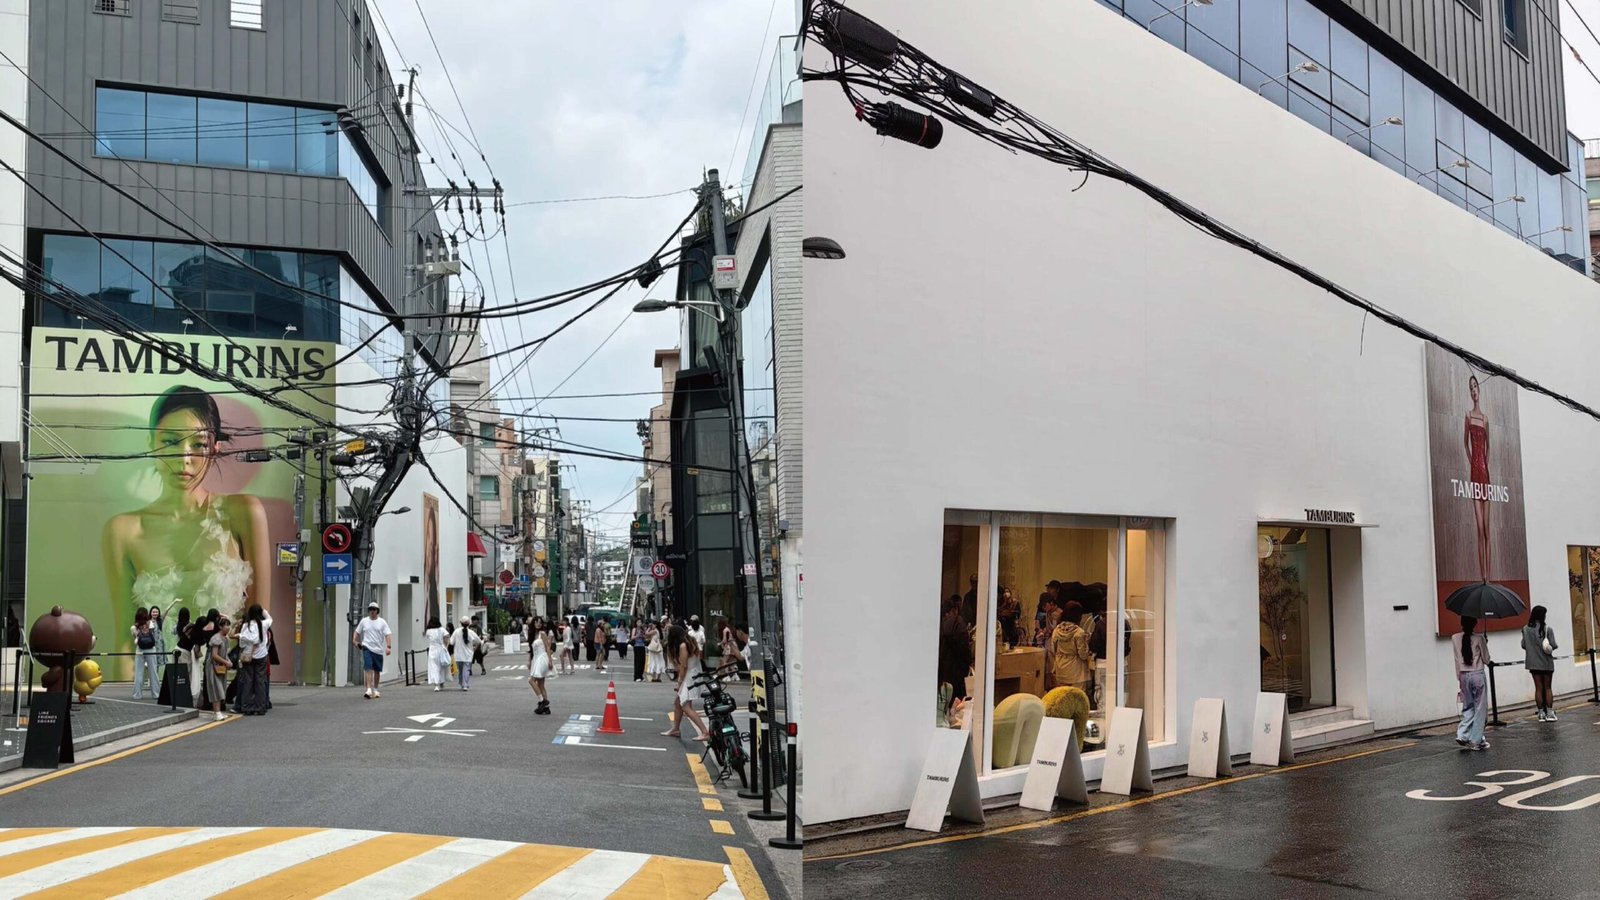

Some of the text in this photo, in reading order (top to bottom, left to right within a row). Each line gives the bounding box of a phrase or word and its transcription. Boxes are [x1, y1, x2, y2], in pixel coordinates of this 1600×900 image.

[45, 336, 325, 381] TAMBURINS
[1450, 478, 1509, 503] TAMBURINS
[1304, 509, 1355, 524] TAMBURINS
[655, 564, 665, 575] 30
[710, 609, 723, 617] SALE
[1405, 770, 1600, 811] 30
